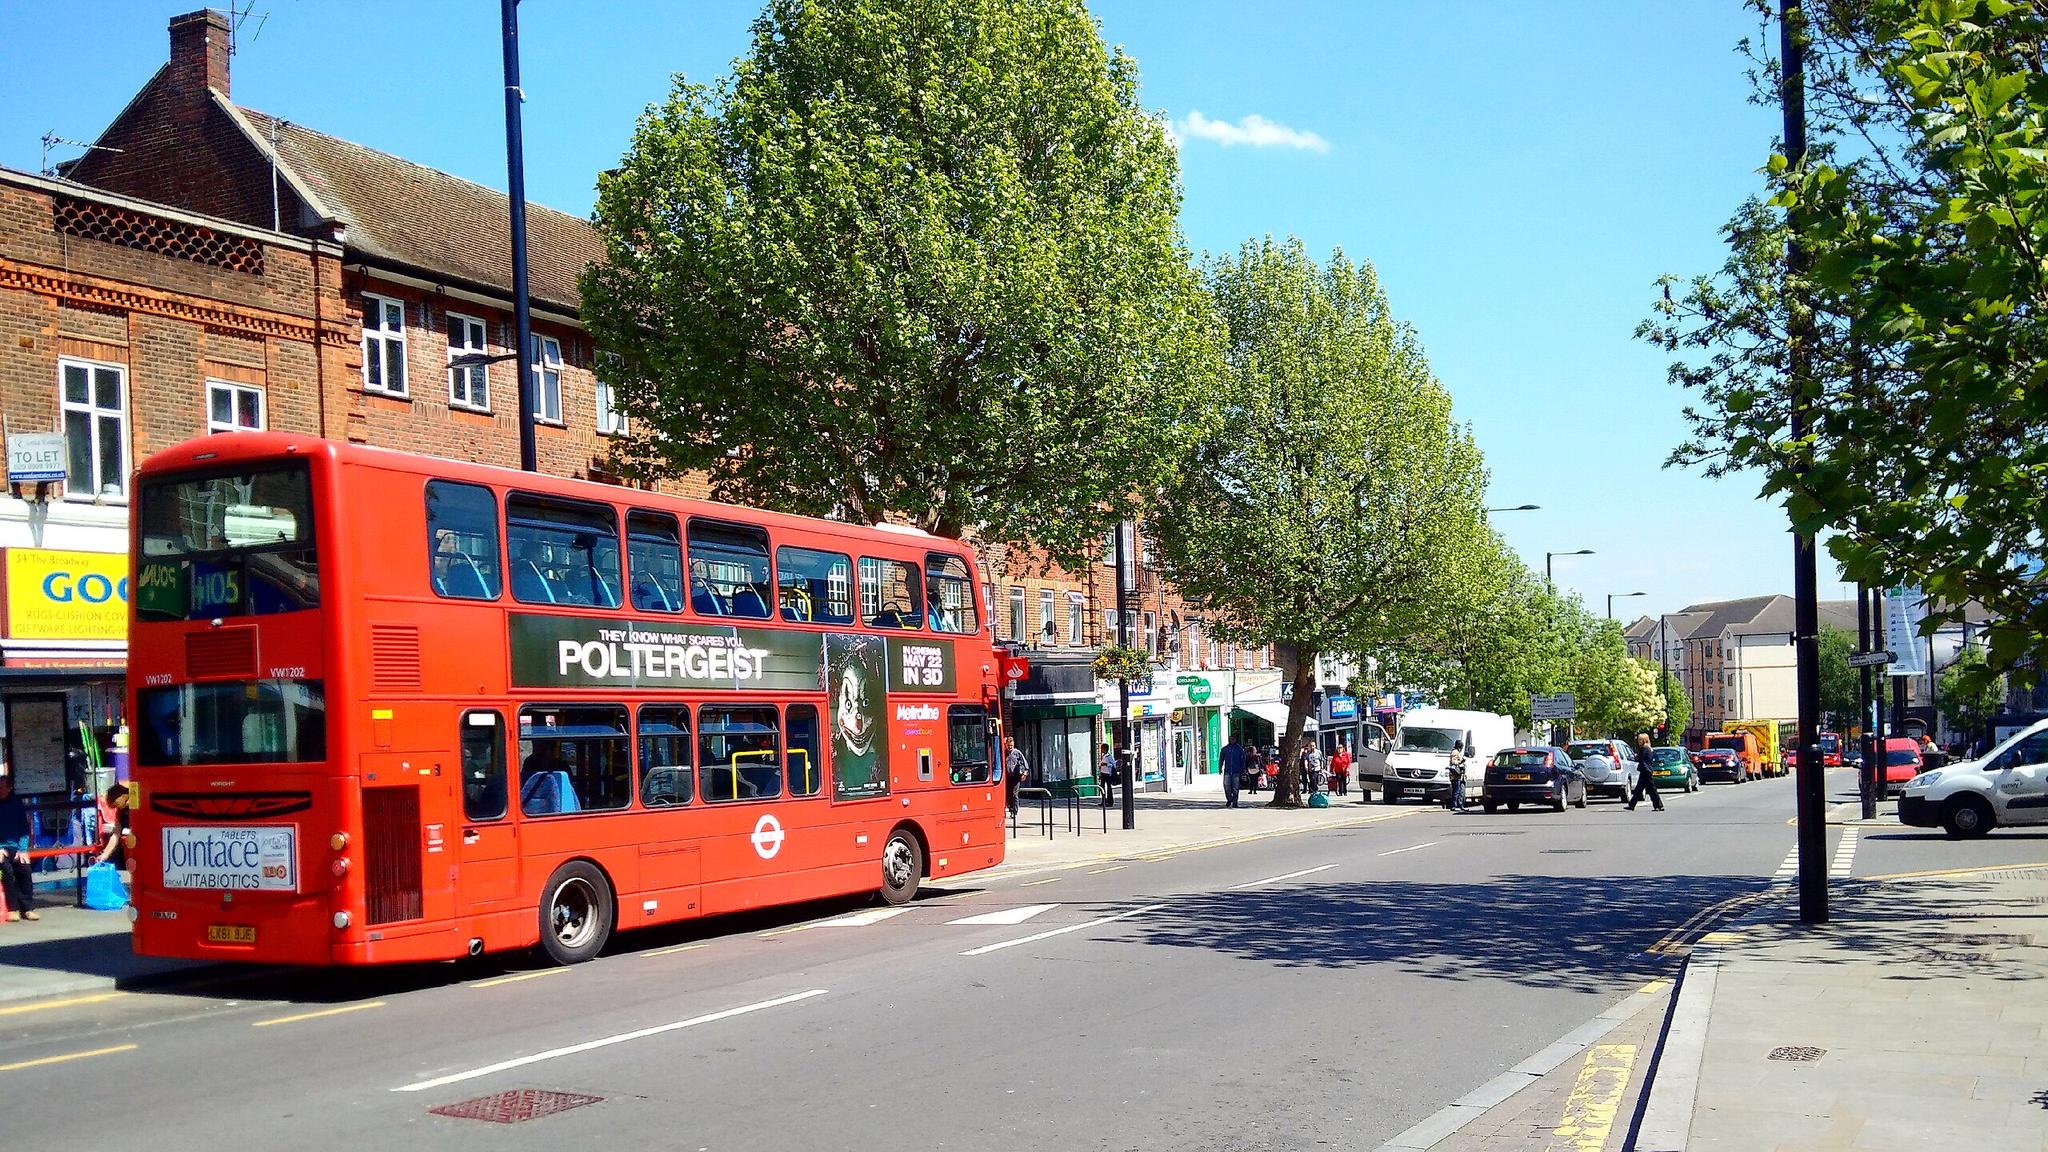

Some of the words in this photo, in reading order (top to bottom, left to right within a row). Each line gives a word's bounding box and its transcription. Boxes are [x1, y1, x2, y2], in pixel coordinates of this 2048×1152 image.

[14, 451, 32, 463] TO
[36, 450, 59, 462] LET
[30, 554, 46, 564] The
[49, 555, 89, 567] Broadway
[599, 629, 626, 642] THEY
[628, 631, 659, 643] KNOW
[660, 633, 687, 645] WHAT
[688, 635, 725, 647] SCARES
[911, 646, 942, 656] CINEMAS
[558, 640, 769, 680] POLTERGEIST
[903, 655, 926, 667] MAY
[927, 655, 942, 668] 22
[145, 674, 172, 684] VW1202
[270, 667, 305, 678] VW1202
[903, 668, 920, 685] IN
[922, 668, 943, 685] 3D
[896, 703, 939, 720] Metroline
[221, 830, 257, 840] TABLETS
[165, 829, 259, 873] Jointace
[165, 879, 182, 887] FROM
[182, 873, 260, 889] VITABIOTICS
